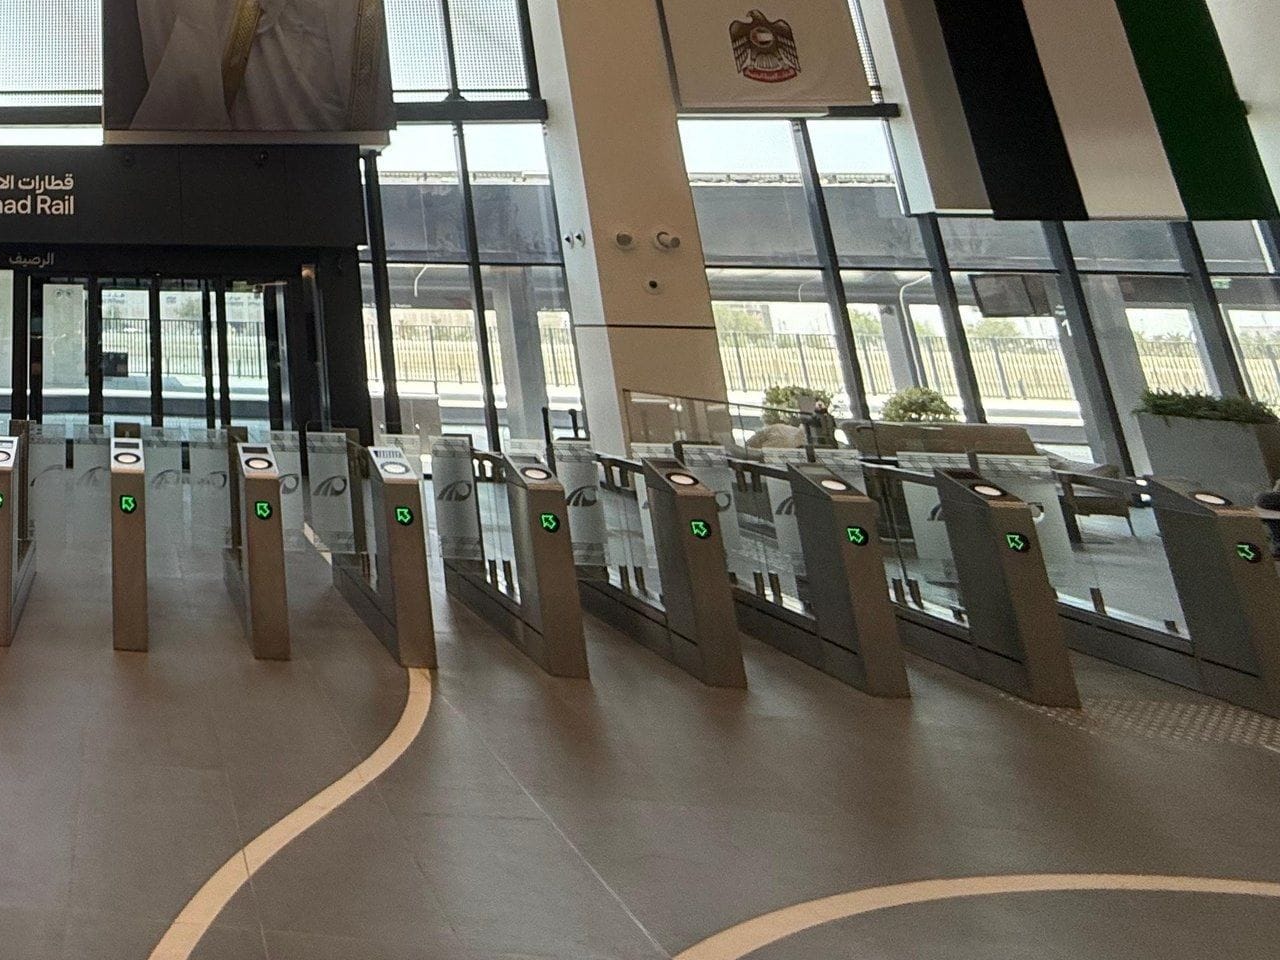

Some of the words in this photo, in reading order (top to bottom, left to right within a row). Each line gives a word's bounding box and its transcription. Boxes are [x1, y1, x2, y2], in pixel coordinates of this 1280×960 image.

[18, 174, 74, 194] قطارات
[36, 195, 74, 215] Rail
[8, 252, 54, 269] الرصيف
[1061, 318, 1073, 337] 1
